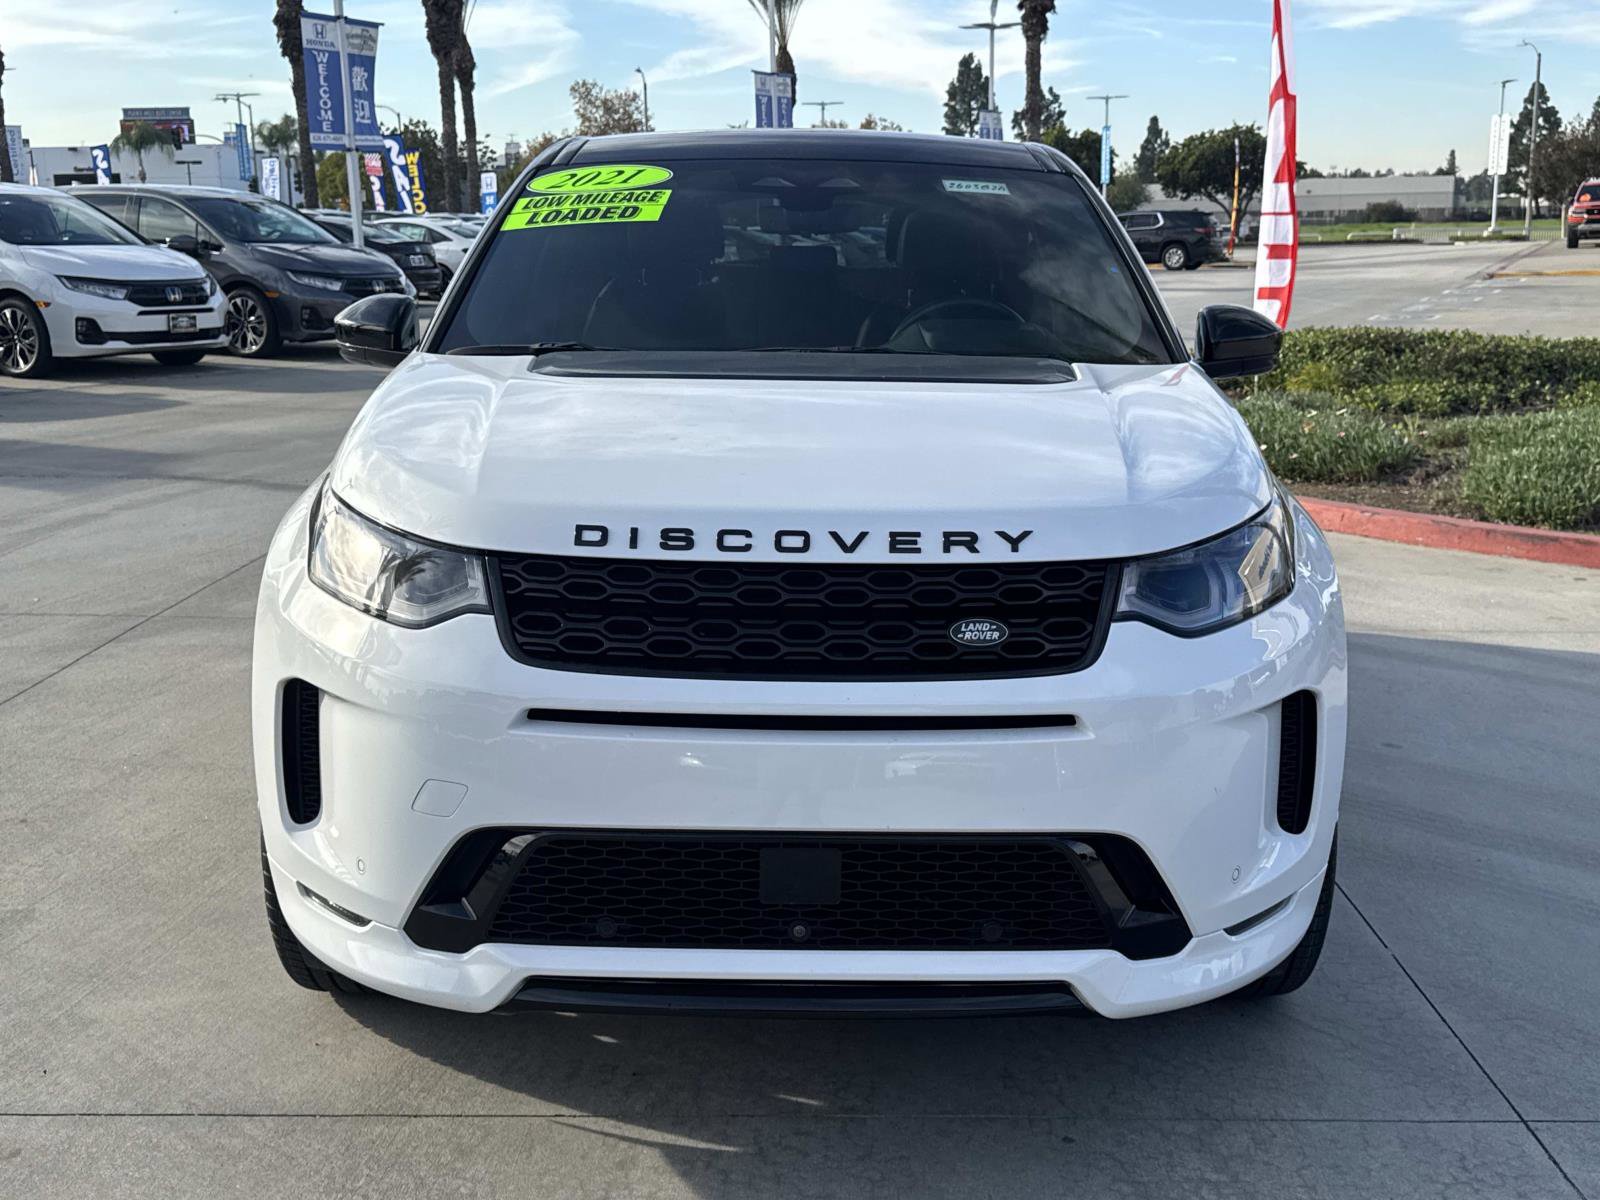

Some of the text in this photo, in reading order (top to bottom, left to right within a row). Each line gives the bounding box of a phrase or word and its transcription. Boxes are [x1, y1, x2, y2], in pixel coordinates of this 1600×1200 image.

[306, 38, 336, 49] HONDA
[312, 50, 334, 132] WELCOME
[546, 168, 647, 190] 2021
[522, 191, 665, 210] LOW MILEAGE
[525, 206, 642, 226] LOADED
[573, 524, 1034, 554] DISCOVERY
